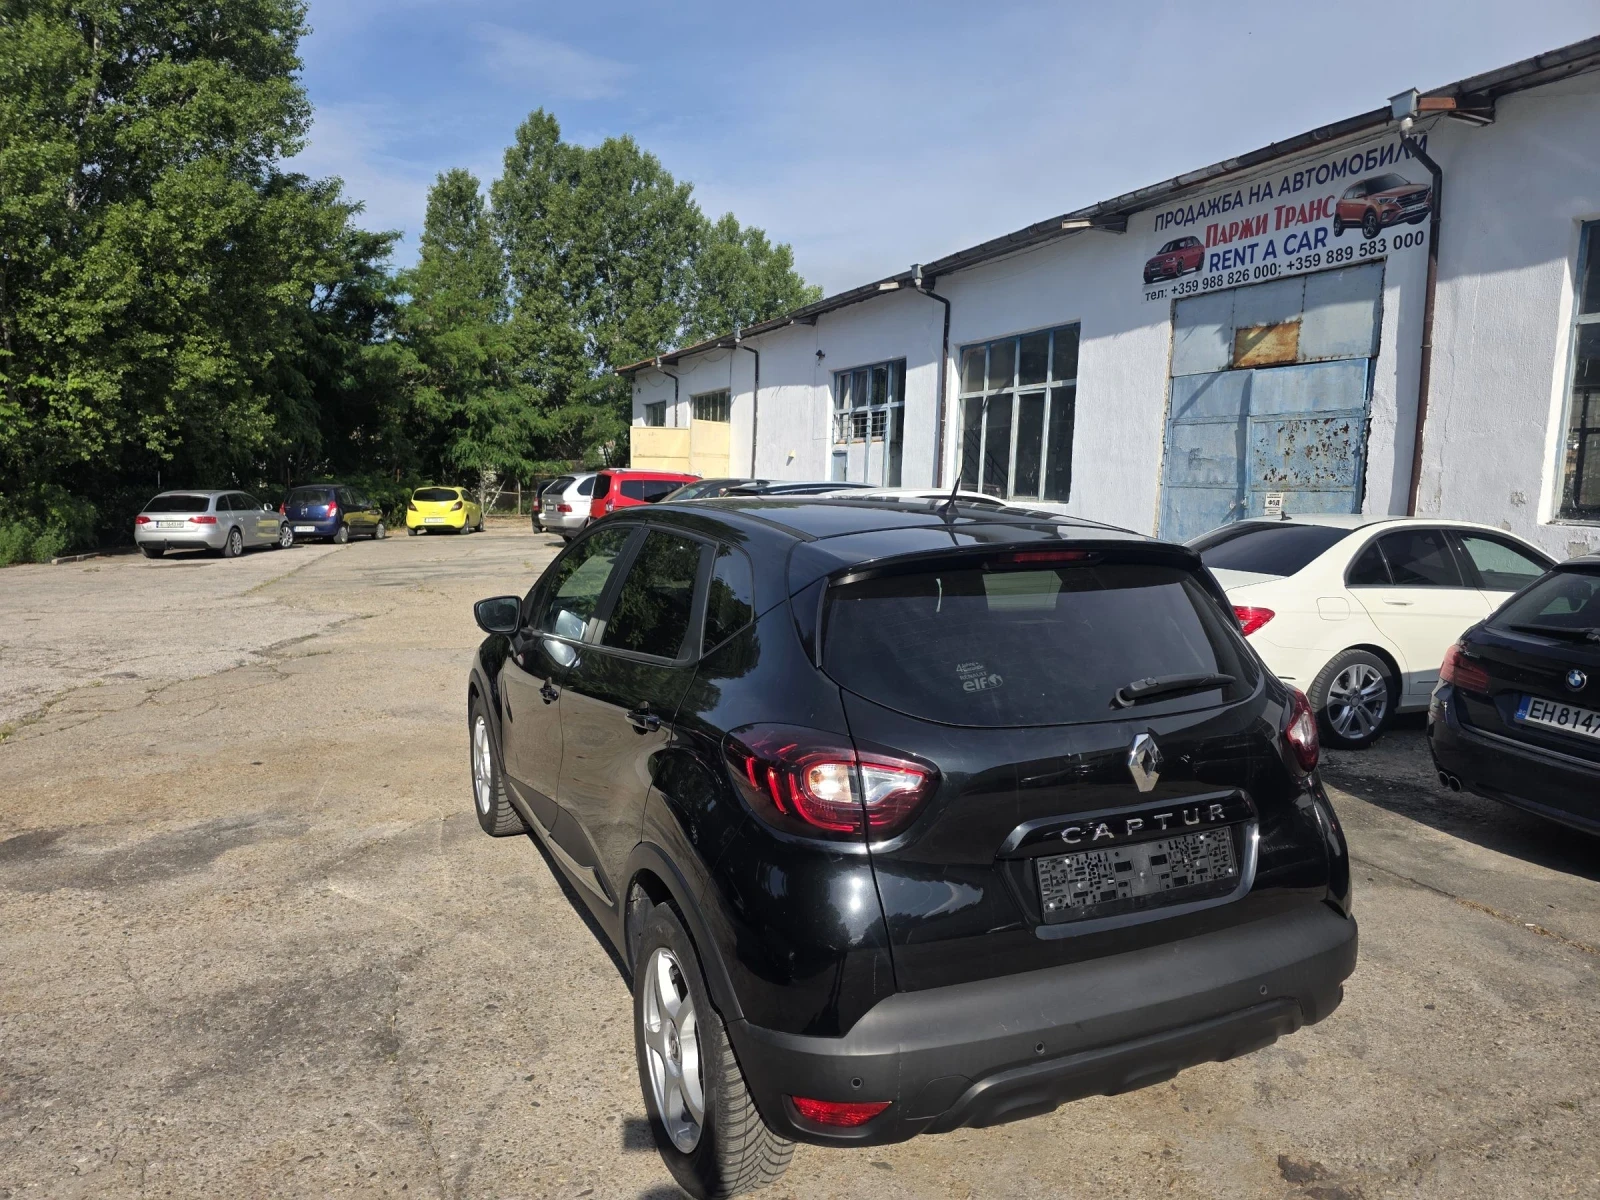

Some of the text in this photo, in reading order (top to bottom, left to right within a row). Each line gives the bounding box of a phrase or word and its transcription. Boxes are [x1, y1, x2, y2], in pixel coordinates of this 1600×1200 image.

[1154, 190, 1244, 233] ПРОДАЖБА
[1248, 180, 1274, 206] НА
[1145, 288, 1168, 302] тел:
[1171, 279, 1199, 295] +359
[1202, 273, 1224, 290] 988
[1227, 268, 1250, 284] 826
[1286, 253, 1321, 271] +359
[1326, 246, 1353, 264] 889
[1359, 238, 1387, 258] 583
[1393, 230, 1425, 250] 000
[1209, 226, 1328, 273] RENT A CAR
[1061, 803, 1226, 845] CAPTUR
